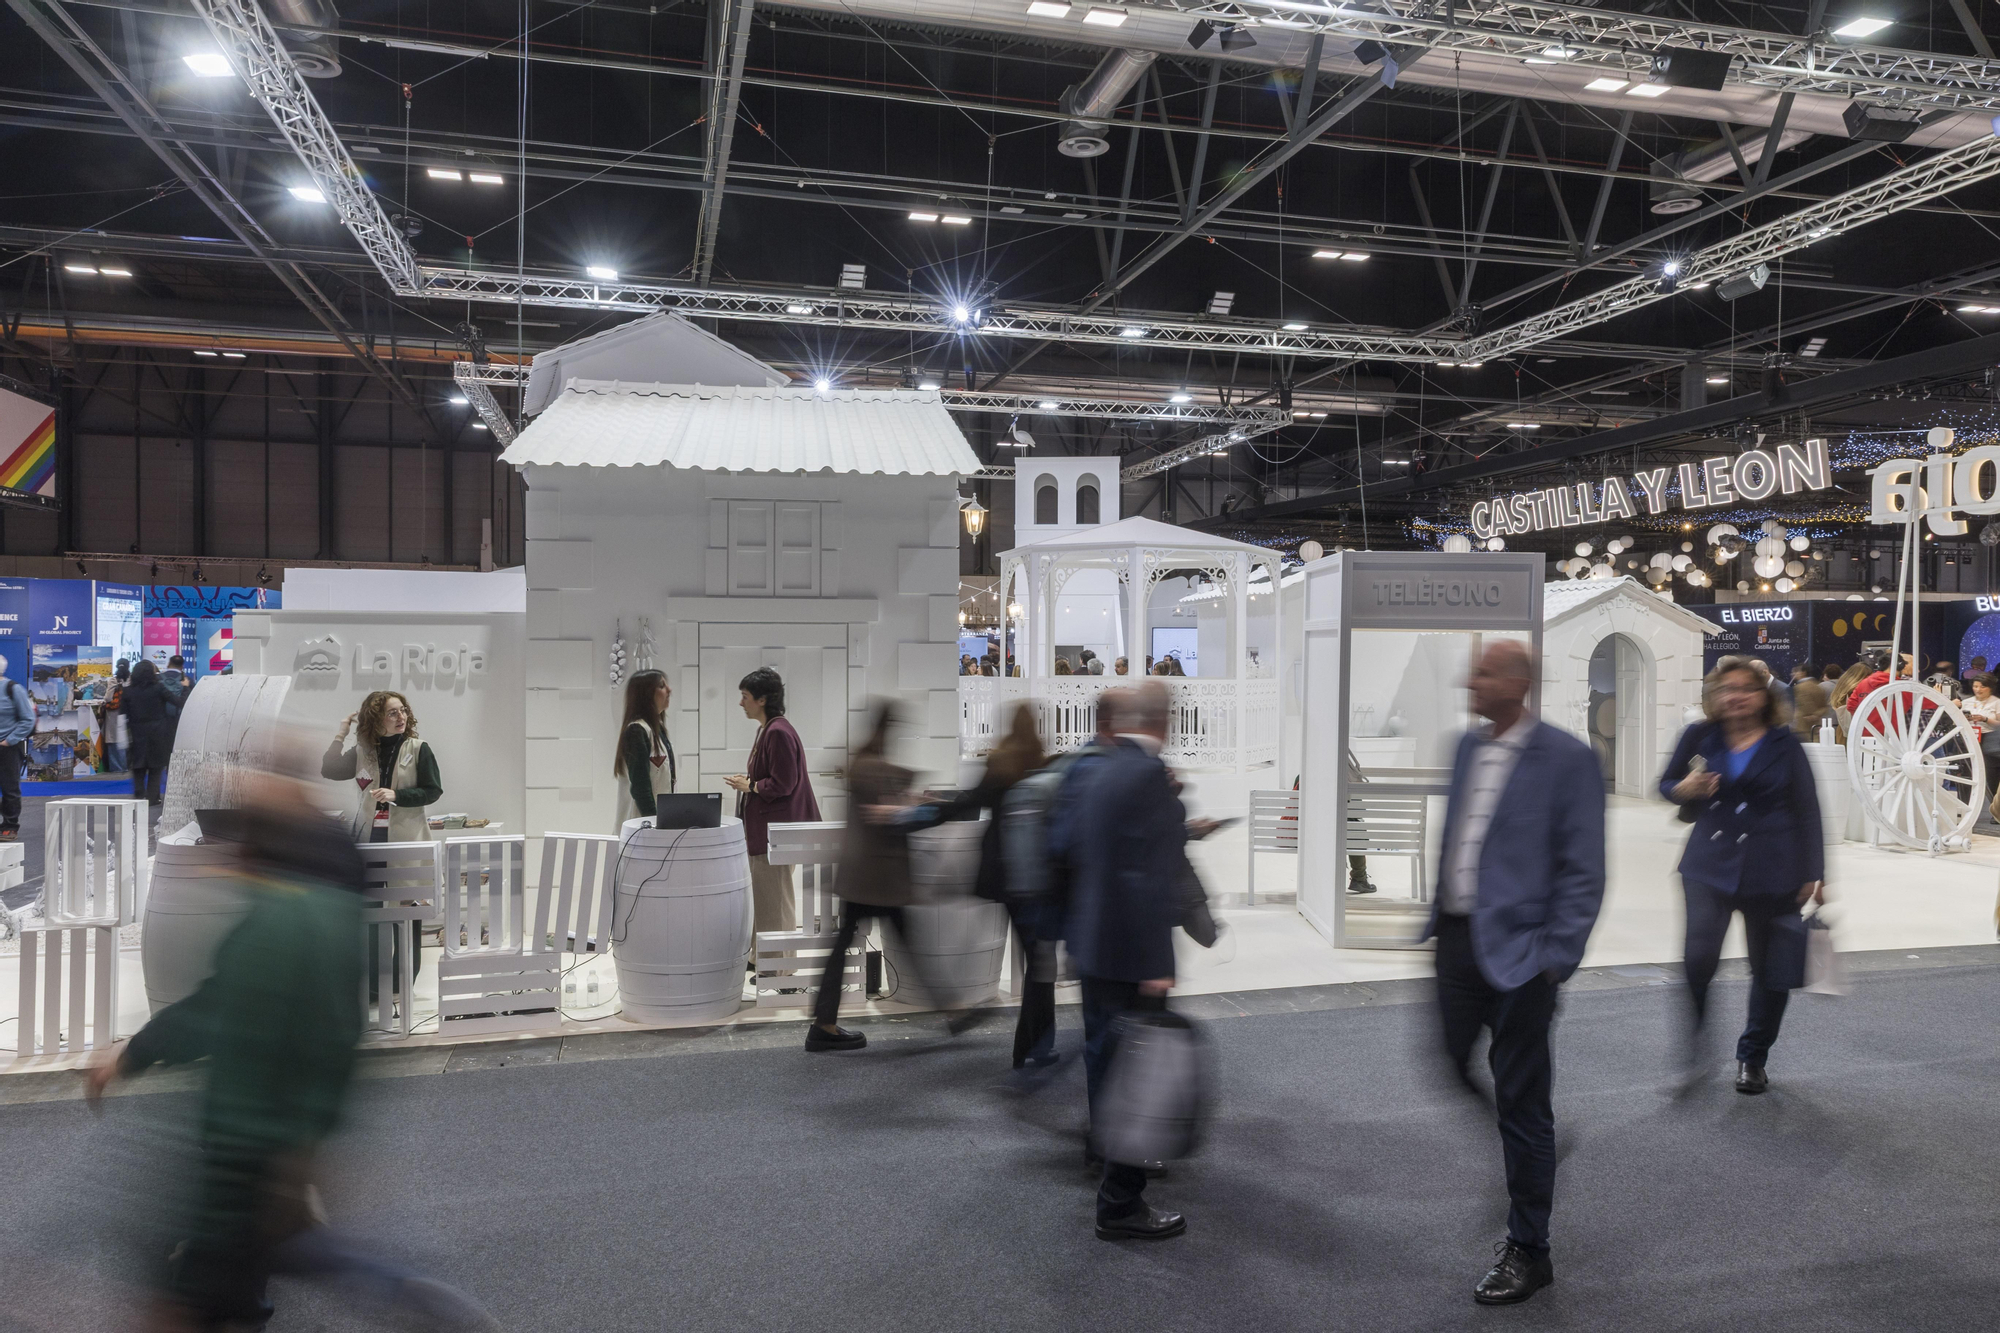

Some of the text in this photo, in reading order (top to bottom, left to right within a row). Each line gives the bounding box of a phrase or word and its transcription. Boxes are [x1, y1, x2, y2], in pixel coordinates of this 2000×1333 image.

[1471, 476, 1635, 539] CASTILLA
[1636, 467, 1670, 514] Y
[1373, 574, 1502, 606] TELÉFONO
[144, 598, 237, 609] NSEXUALIA
[1597, 597, 1650, 616] BODEGA
[1721, 606, 1793, 622] EL BIERZO
[1722, 632, 1741, 641] LEÓN,
[356, 642, 487, 680] La Rioja
